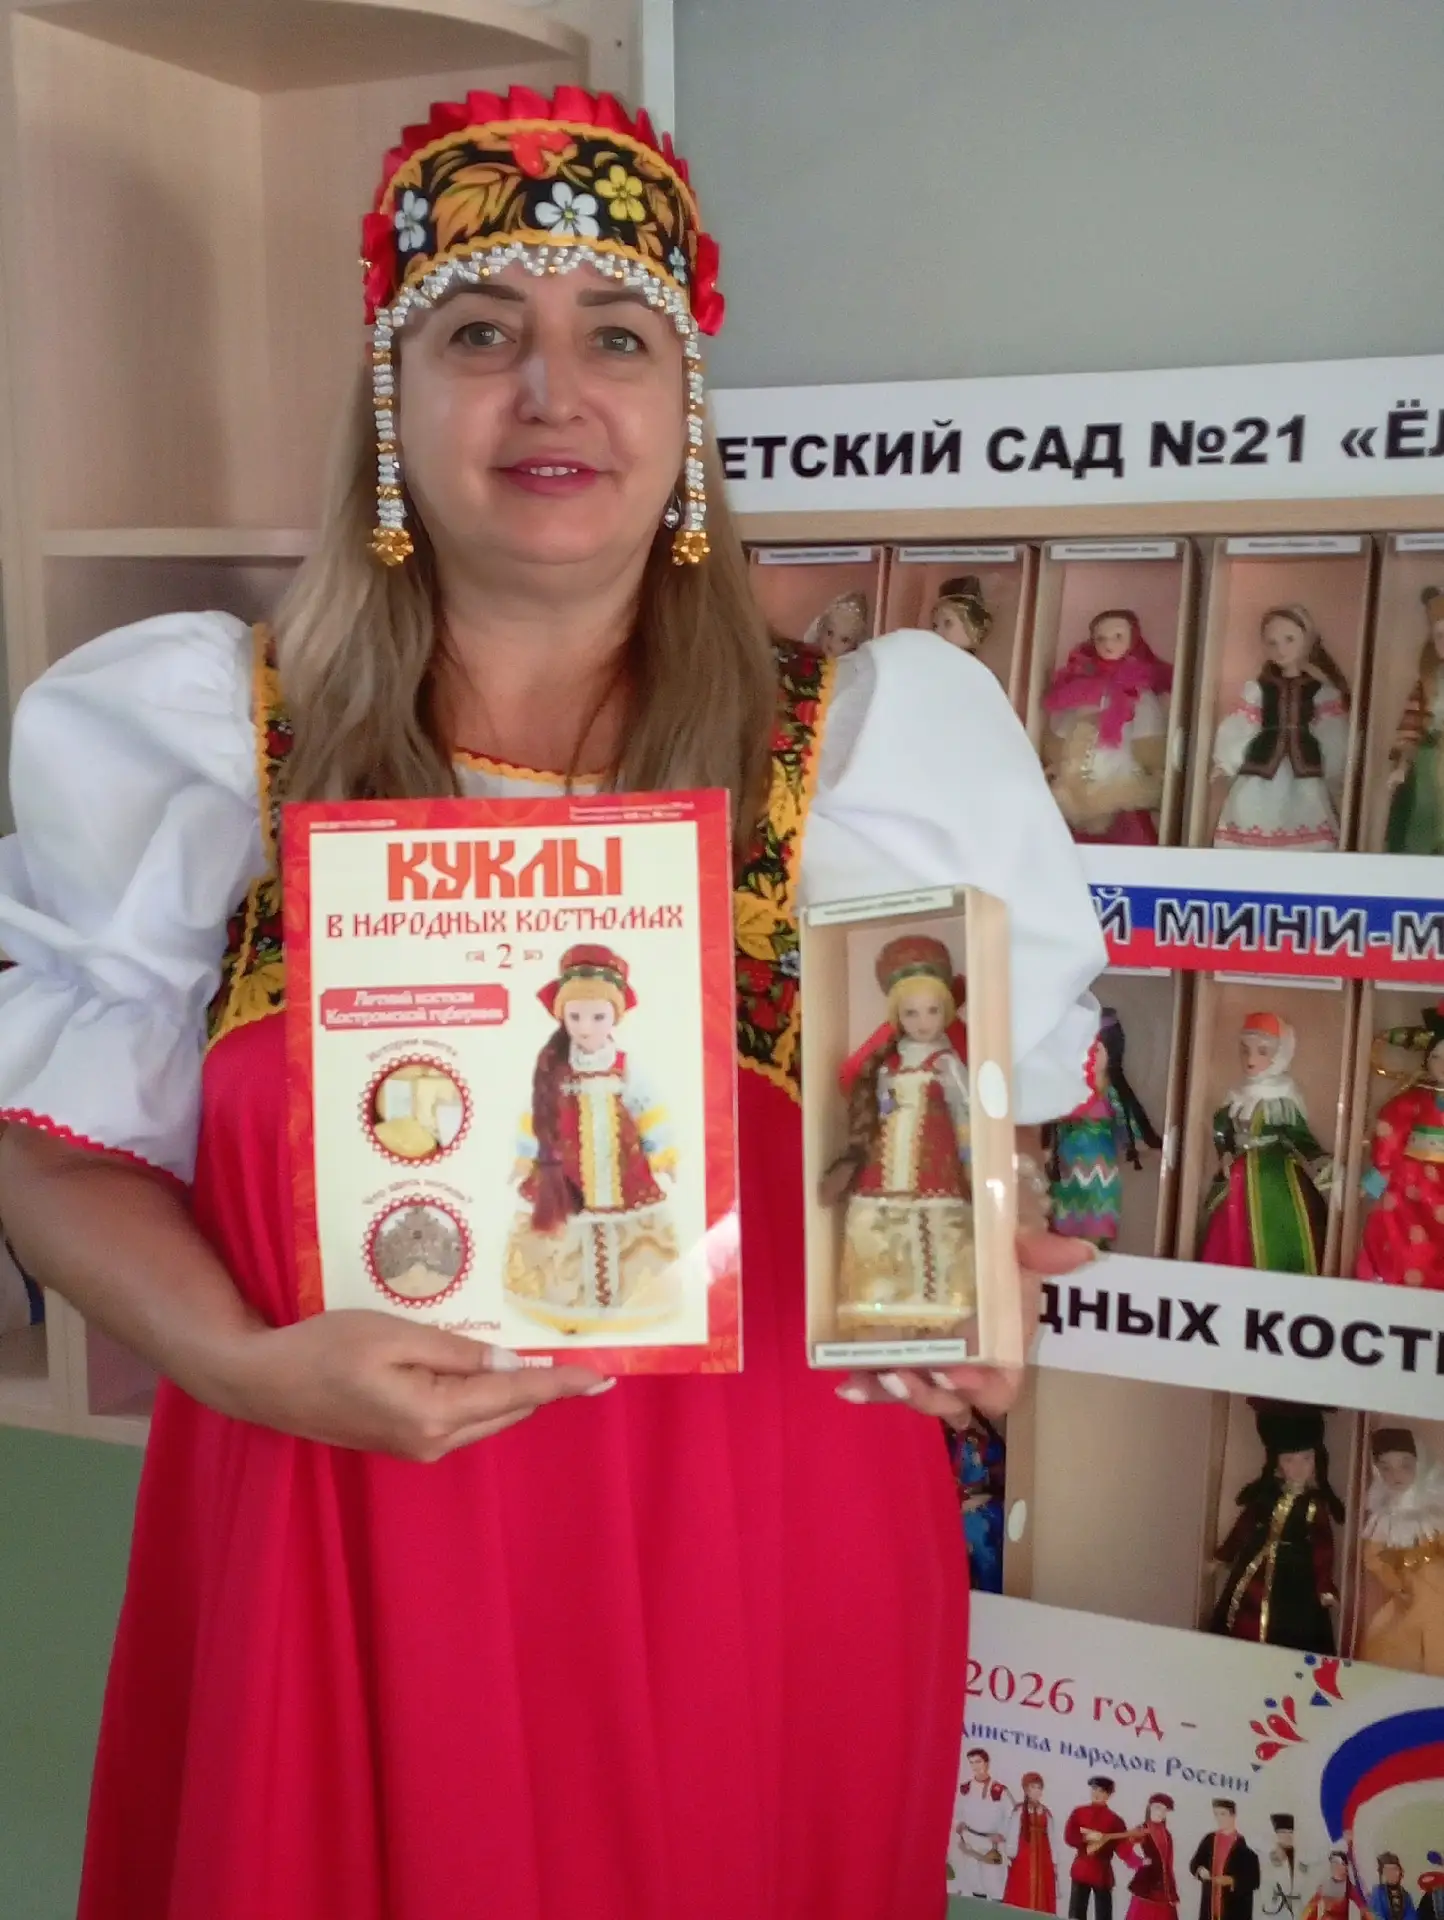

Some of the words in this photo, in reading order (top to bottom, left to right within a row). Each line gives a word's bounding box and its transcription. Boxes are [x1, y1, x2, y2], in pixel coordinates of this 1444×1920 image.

[985, 422, 1125, 480] САД
[1149, 413, 1306, 468] №21
[386, 837, 624, 901] КУКЛЫ
[326, 914, 343, 939] В
[352, 910, 507, 940] НАРОДНЫХ
[515, 905, 684, 934] КОСТЮМАХ
[1155, 898, 1444, 962] МИНИ-М
[496, 944, 514, 969] 2
[965, 1659, 1076, 1716] 2026
[1092, 1696, 1165, 1742] год
[1059, 1740, 1156, 1774] народов
[1165, 1755, 1250, 1793] России
